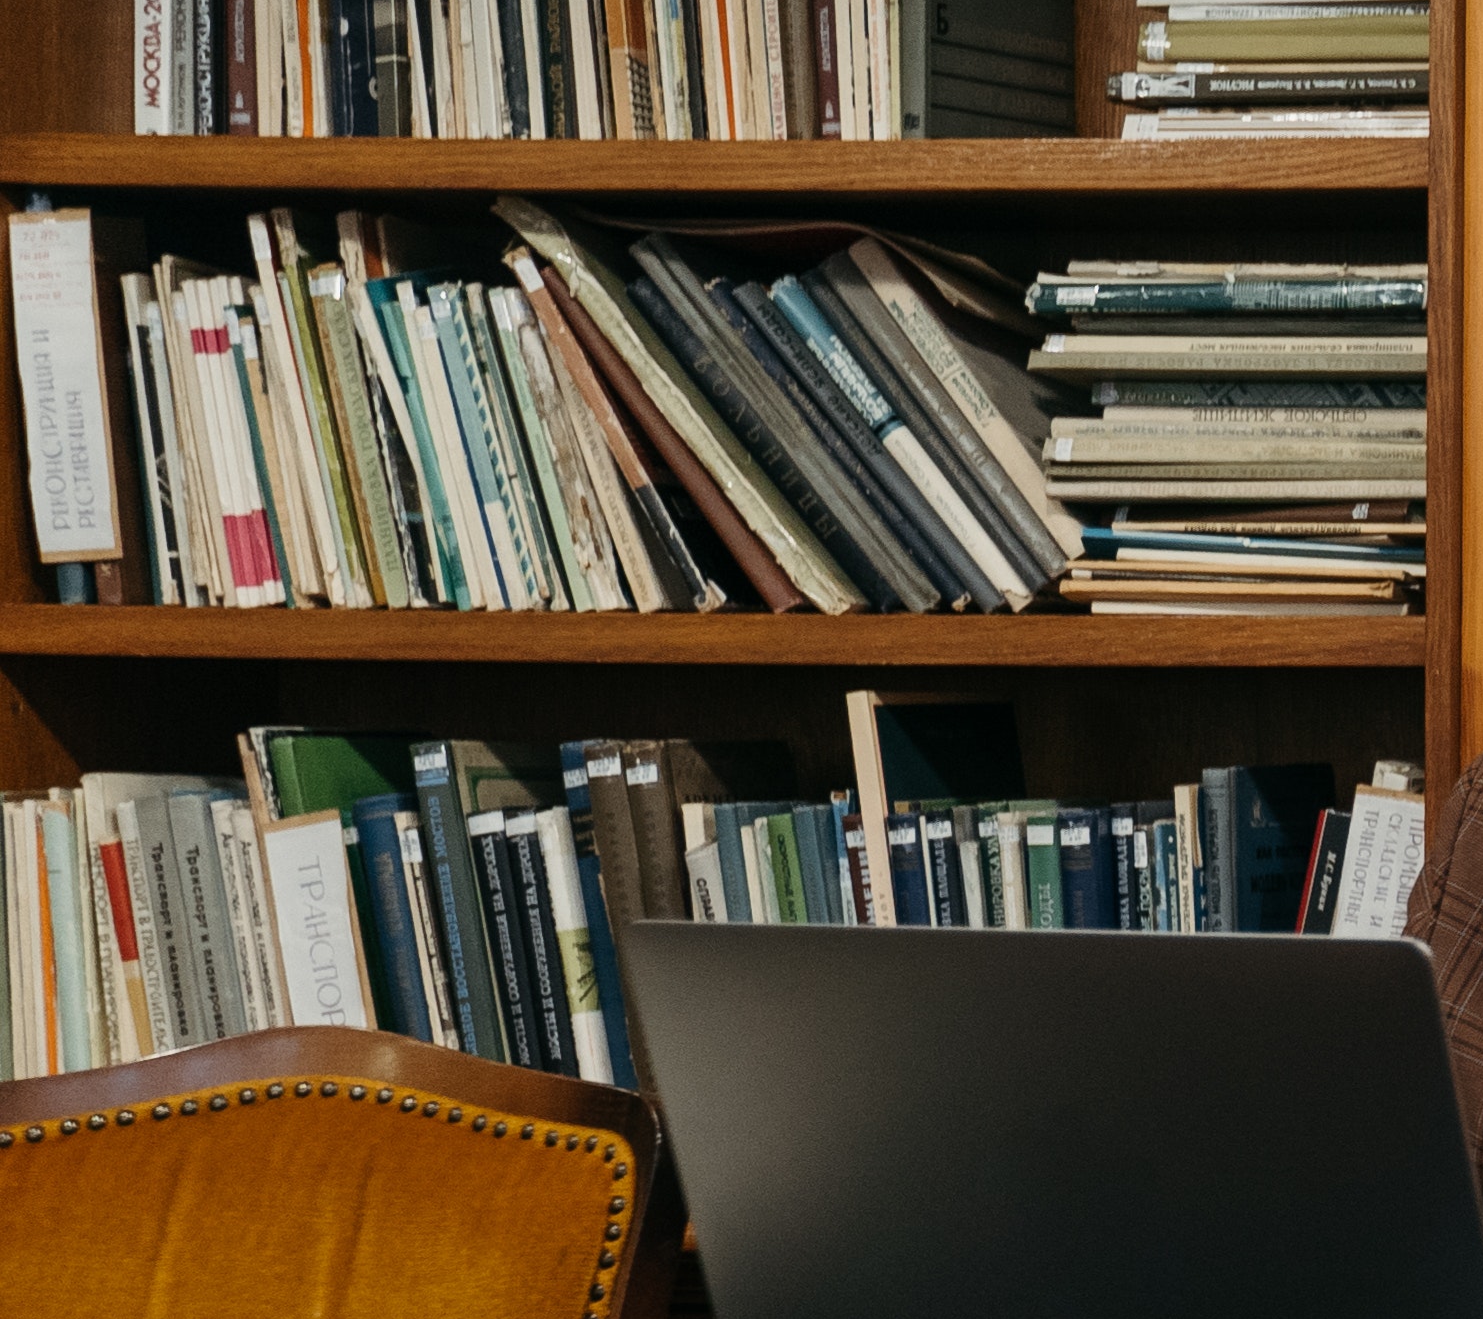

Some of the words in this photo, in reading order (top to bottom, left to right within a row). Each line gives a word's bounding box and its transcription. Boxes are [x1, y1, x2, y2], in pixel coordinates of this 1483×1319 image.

[1209, 79, 1255, 92] РИСУНОК
[33, 329, 51, 344] И
[36, 355, 70, 531] РЕКОНСТРУКЦИЯ
[1192, 408, 1274, 422] ЖИЛИЩЕ
[1284, 408, 1366, 422] СЕЛЬСКОЕ
[66, 389, 96, 530] РЕСТАВРАЦИЯ
[425, 795, 448, 858] МОСТОВ
[150, 842, 174, 926] Транспорт
[187, 845, 211, 929] Транспорт
[695, 877, 715, 922] СПРАВ
[930, 837, 951, 895] ПЛОЩАДЕ
[1116, 836, 1130, 894] ПЛОЩАДЕ
[1342, 808, 1381, 926] ТРАНСПОРТНЫЕ
[164, 930, 175, 940] и
[201, 933, 212, 943] и
[298, 854, 345, 1026] ТРАНСПОР
[436, 862, 471, 999] ВОССТАНОВЛЕНИЕ
[498, 911, 521, 1000] СООРУЖЕНИЯ
[529, 906, 552, 996] СООРУЖЕНИЯ
[139, 929, 170, 1051] ГРАДОСТРОИТЕЛЬС
[165, 945, 190, 1037] планировка
[203, 948, 228, 1039] планировка
[513, 1016, 531, 1065] МОСТЫ
[544, 1009, 562, 1060] МОСТЫ
